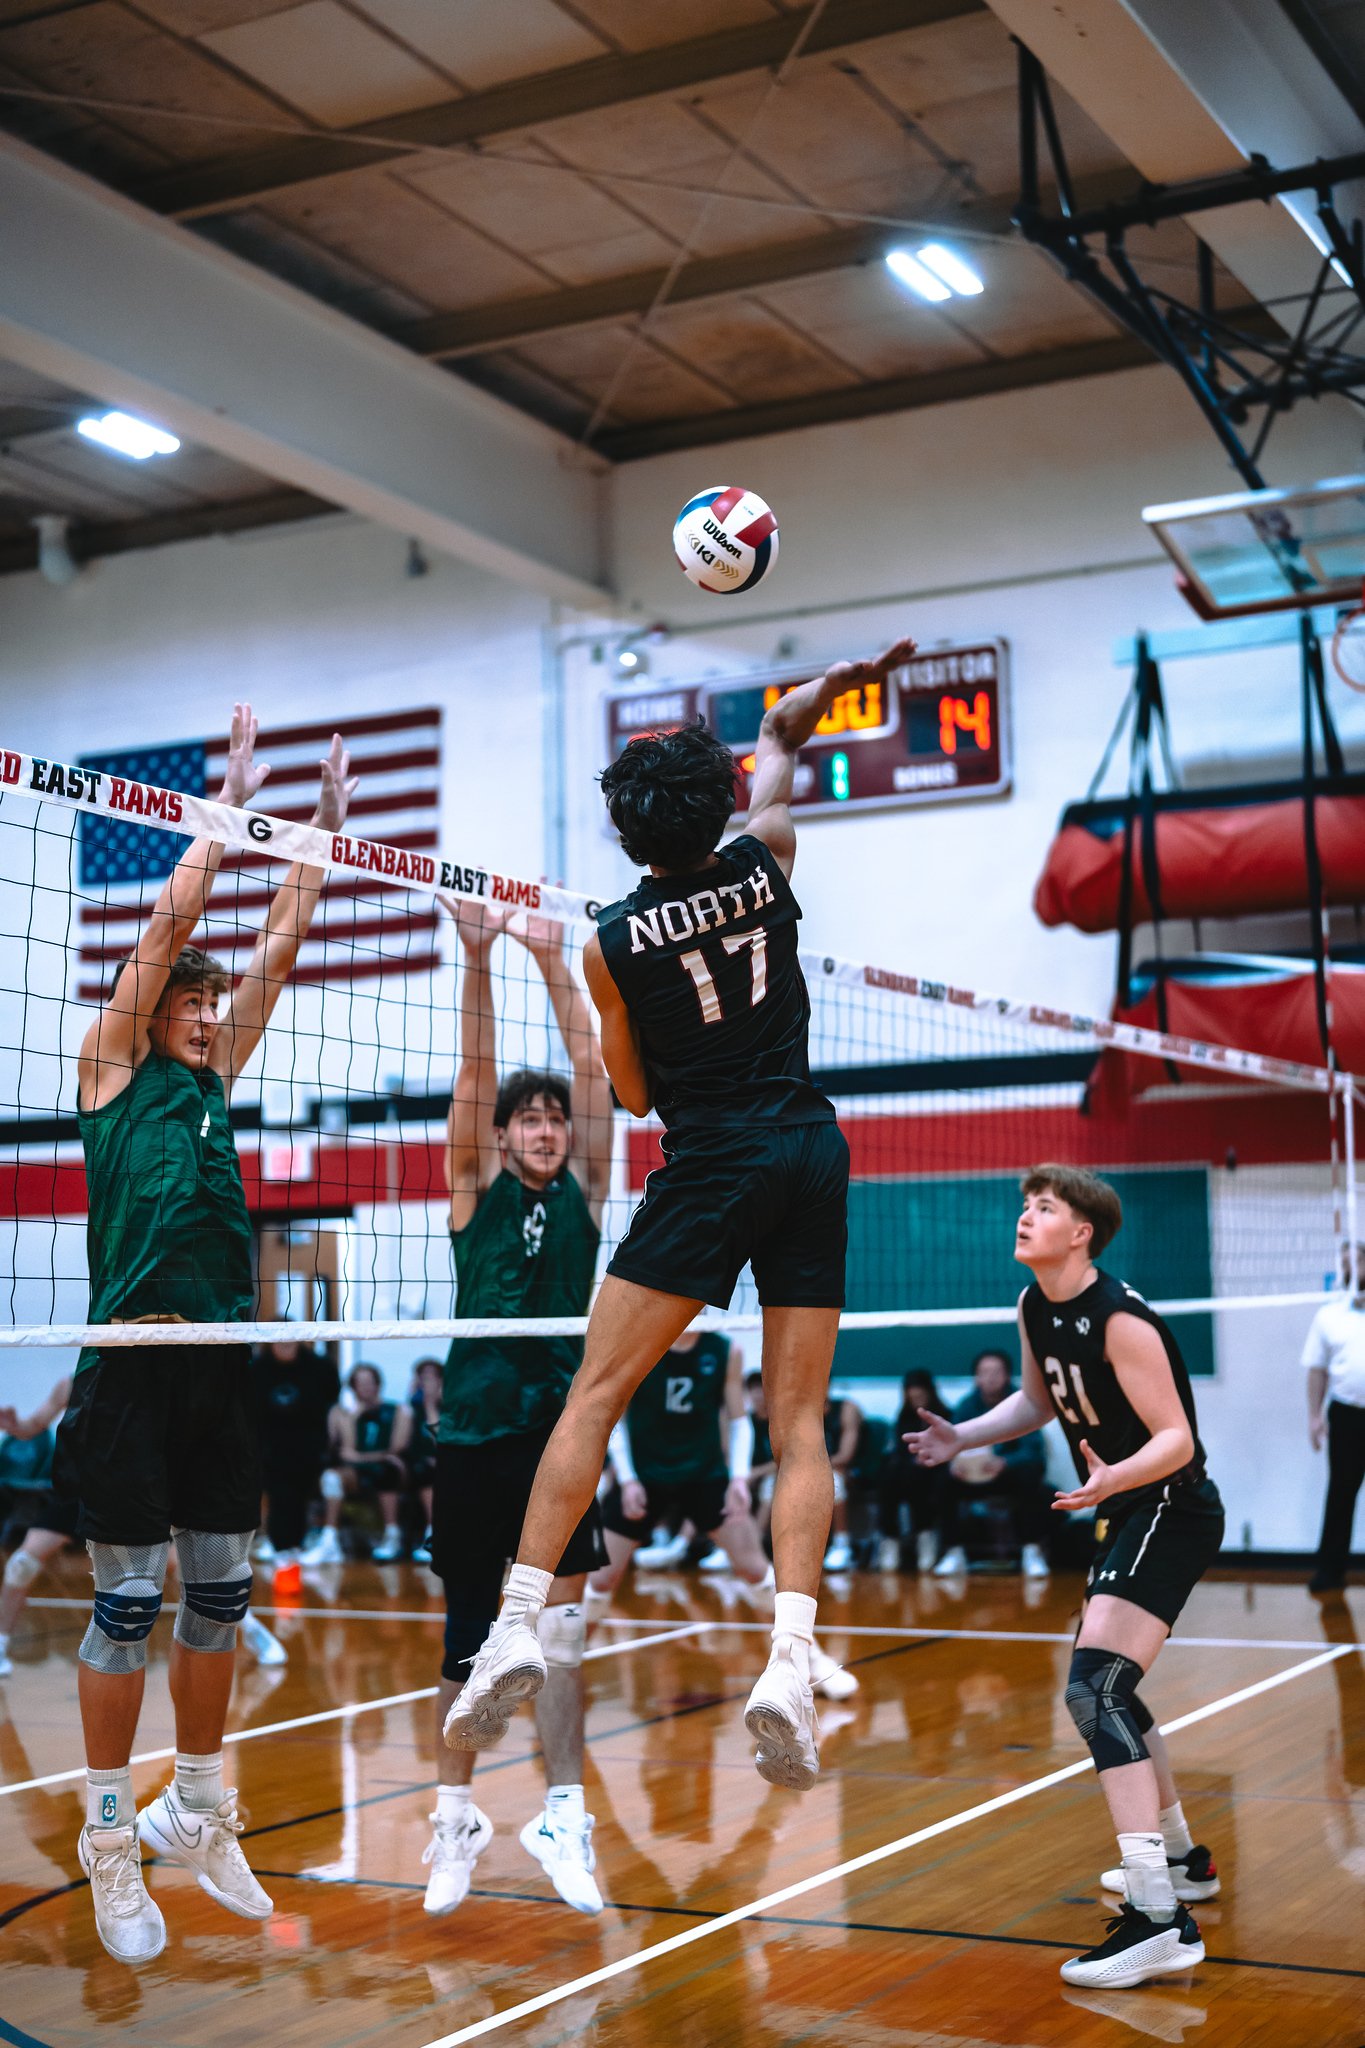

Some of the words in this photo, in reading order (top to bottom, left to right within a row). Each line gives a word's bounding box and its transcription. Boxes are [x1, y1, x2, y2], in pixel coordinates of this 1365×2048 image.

[703, 519, 742, 560] Wilson
[896, 650, 994, 690] VISITOR
[939, 690, 991, 755] 14
[0, 751, 22, 785] D
[30, 757, 101, 804] EAST
[109, 777, 183, 823] RAMS
[332, 834, 435, 884] GLENBARD
[440, 861, 488, 897] EAST
[491, 874, 541, 909] RAMS
[627, 865, 775, 954] NORTH
[679, 925, 768, 1024] 17
[665, 1376, 693, 1413] 12
[1044, 1356, 1101, 1426] 21
